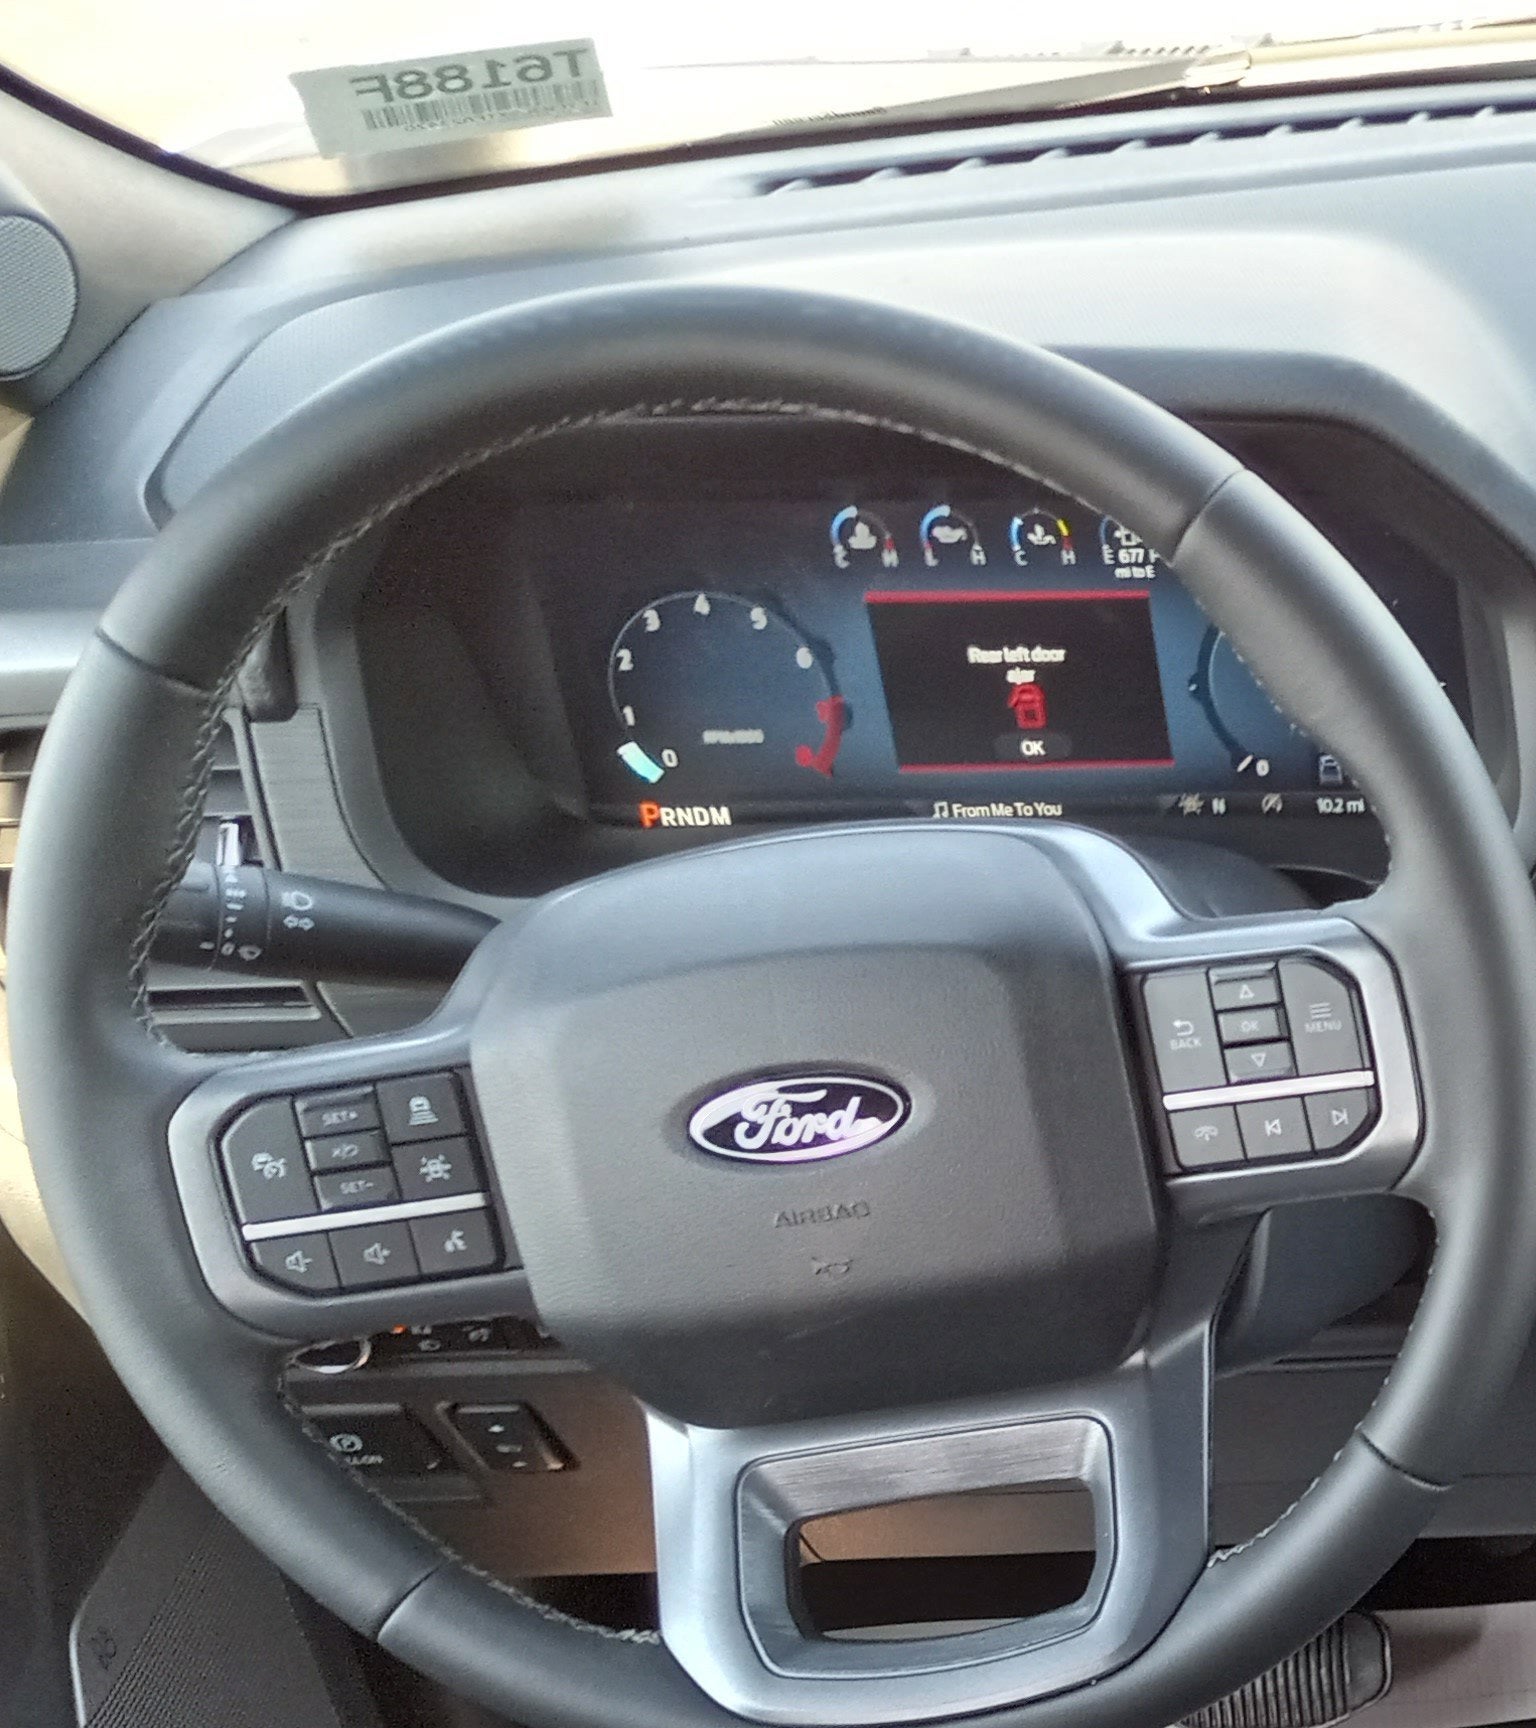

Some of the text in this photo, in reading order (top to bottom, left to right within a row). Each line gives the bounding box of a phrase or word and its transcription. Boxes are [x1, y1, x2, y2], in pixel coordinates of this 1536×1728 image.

[692, 593, 711, 616] 4
[643, 609, 661, 632] 3
[750, 606, 768, 630] 5
[616, 648, 634, 671] 2
[623, 705, 636, 727] 1
[661, 748, 679, 768] 0
[1020, 740, 1045, 756] OK
[952, 801, 1063, 818] From Me To You
[1240, 1020, 1260, 1033] OK
[1304, 1019, 1342, 1034] MENU
[734, 1087, 885, 1150] Ford
